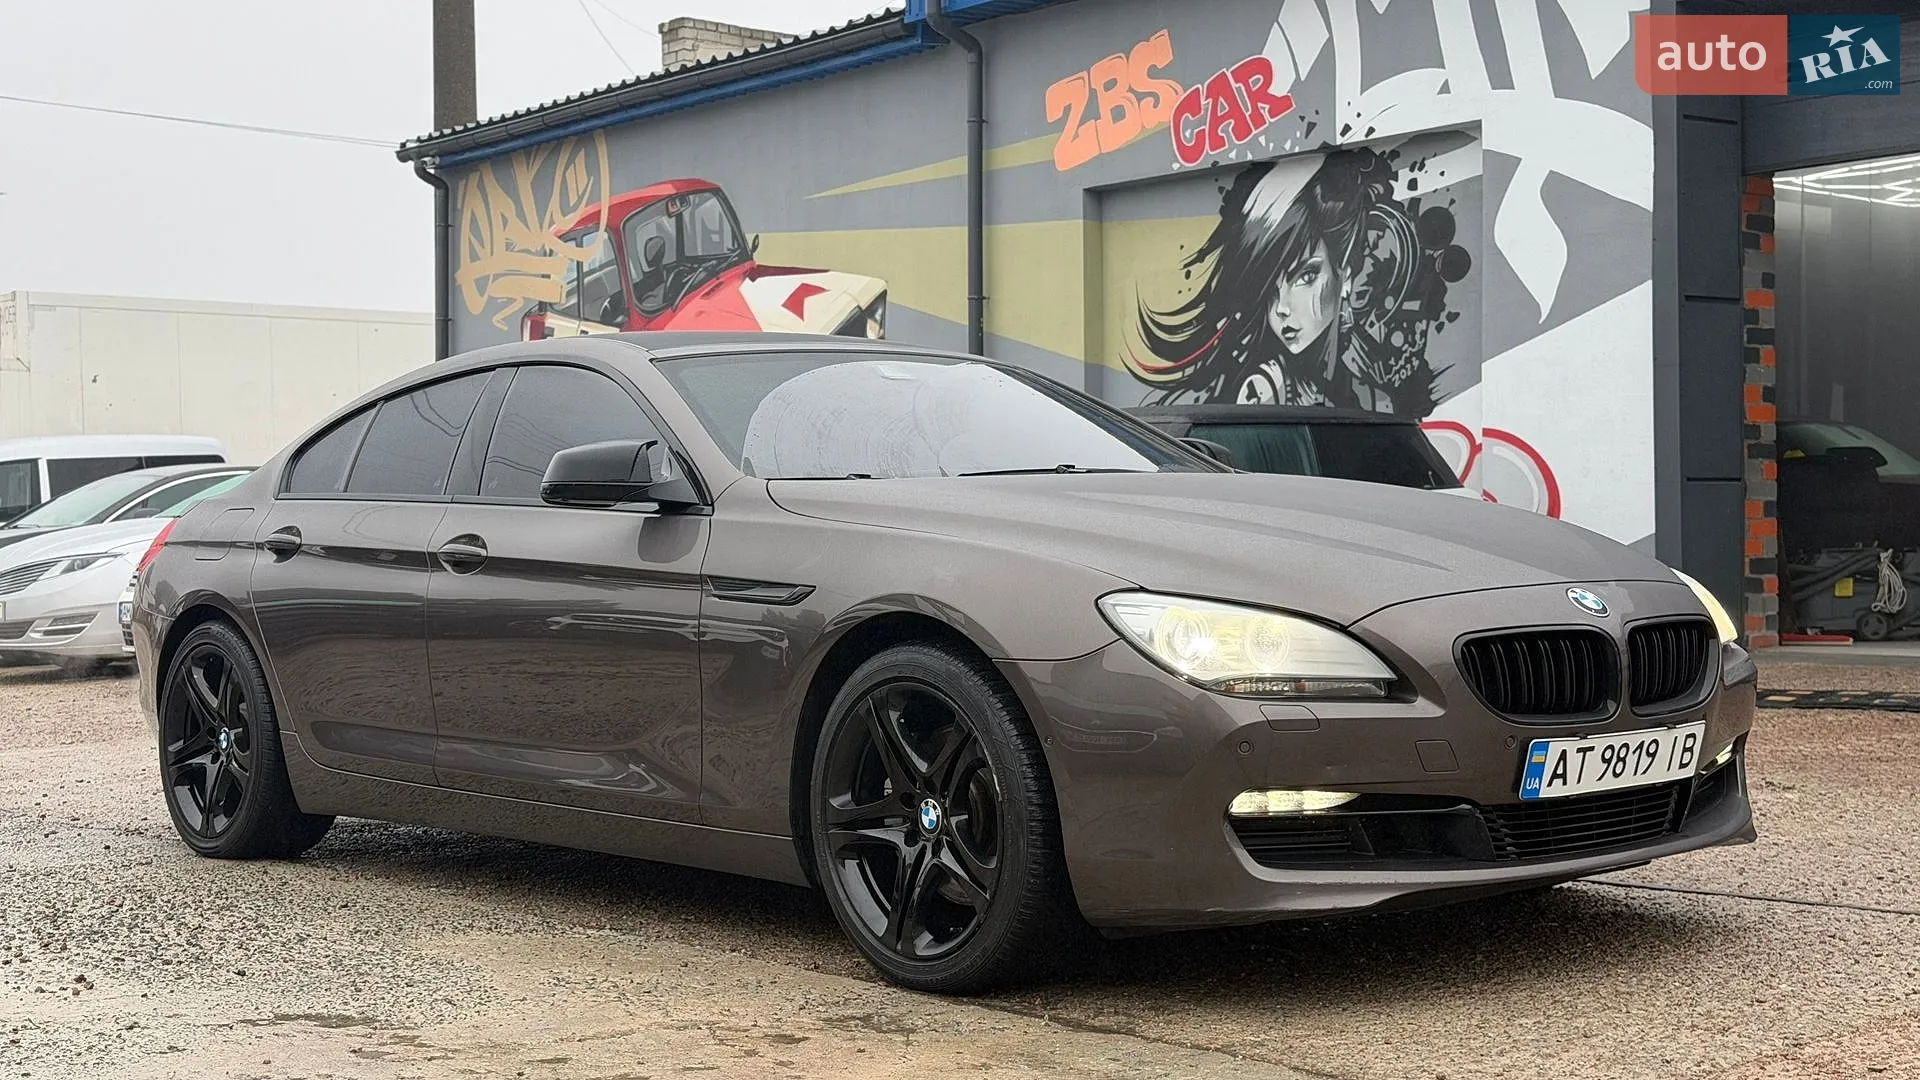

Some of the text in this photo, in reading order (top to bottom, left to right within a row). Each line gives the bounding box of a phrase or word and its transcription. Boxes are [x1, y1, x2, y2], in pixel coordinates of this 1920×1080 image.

[1045, 28, 1296, 172] ZBS CAR
[1526, 777, 1540, 790] UA
[1546, 732, 1697, 788] AT 9819 IB
